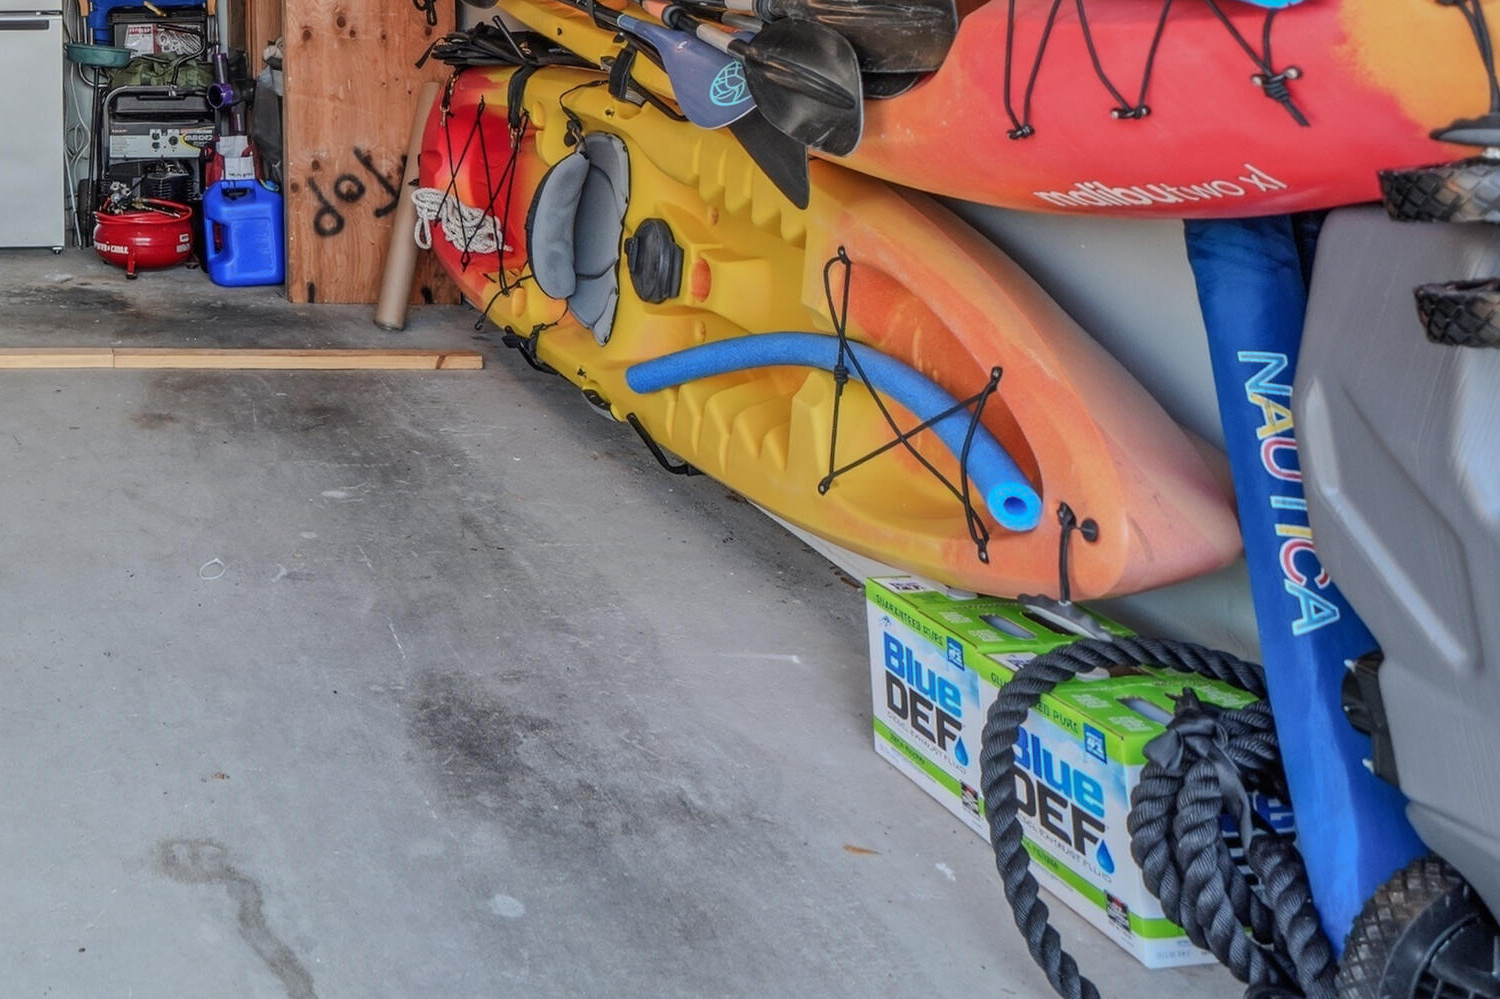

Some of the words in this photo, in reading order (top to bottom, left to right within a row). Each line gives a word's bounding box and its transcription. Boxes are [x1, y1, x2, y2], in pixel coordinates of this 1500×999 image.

[883, 631, 962, 718] Blue
[885, 671, 964, 751] DEF
[1013, 725, 1105, 819] Blue
[1014, 768, 1106, 855] DEF
